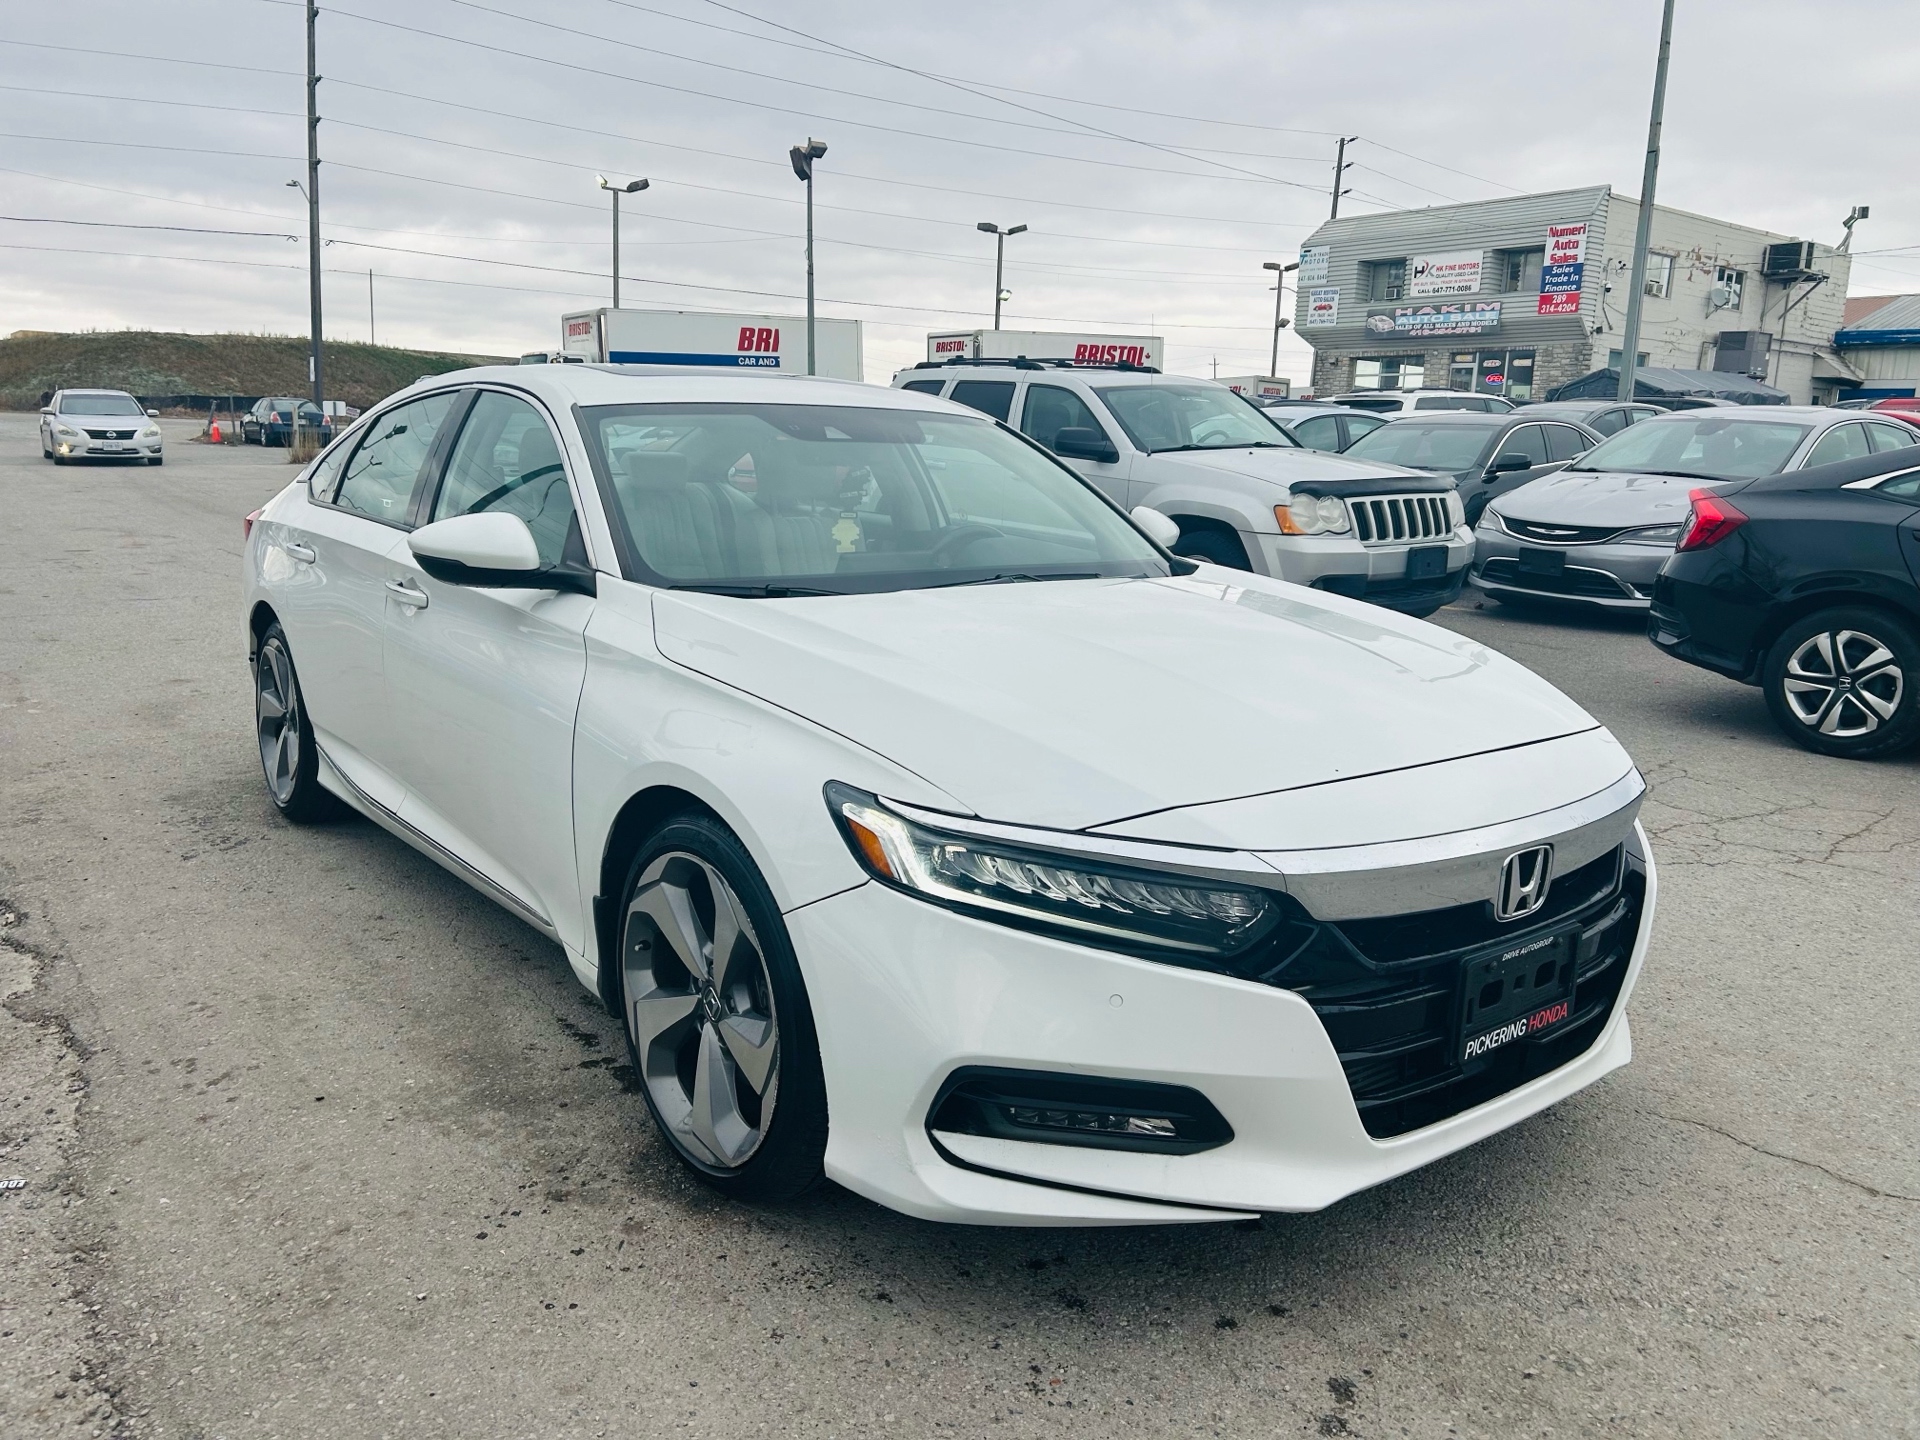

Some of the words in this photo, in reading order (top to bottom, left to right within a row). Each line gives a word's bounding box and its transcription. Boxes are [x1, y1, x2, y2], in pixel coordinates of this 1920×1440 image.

[1549, 223, 1587, 238] Numeri
[1552, 239, 1579, 251] Auto
[1304, 258, 1329, 266] MOTORS
[1550, 252, 1578, 265] Sales
[1457, 262, 1480, 271] MOTORS
[1551, 266, 1574, 274] Sales
[1544, 274, 1568, 283] Trade
[1570, 273, 1579, 281] In
[1544, 283, 1577, 293] Finance
[1552, 294, 1566, 304] 289
[1540, 302, 1576, 314] 314-4204
[1396, 314, 1445, 325] AUTO
[1449, 311, 1499, 321] SALE
[568, 321, 591, 336] BRISTOL
[737, 327, 779, 352] BRI
[935, 340, 965, 353] BRISTOL
[1073, 343, 1145, 367] BRISTOL
[738, 357, 756, 365] CAR
[757, 357, 776, 366] AND
[1262, 387, 1281, 396] BRISTOL
[1501, 948, 1521, 961] DRIVE
[1520, 936, 1554, 956] AUTOGROUP
[1464, 1018, 1527, 1060] PICKERING
[1527, 1002, 1568, 1032] HONDA
